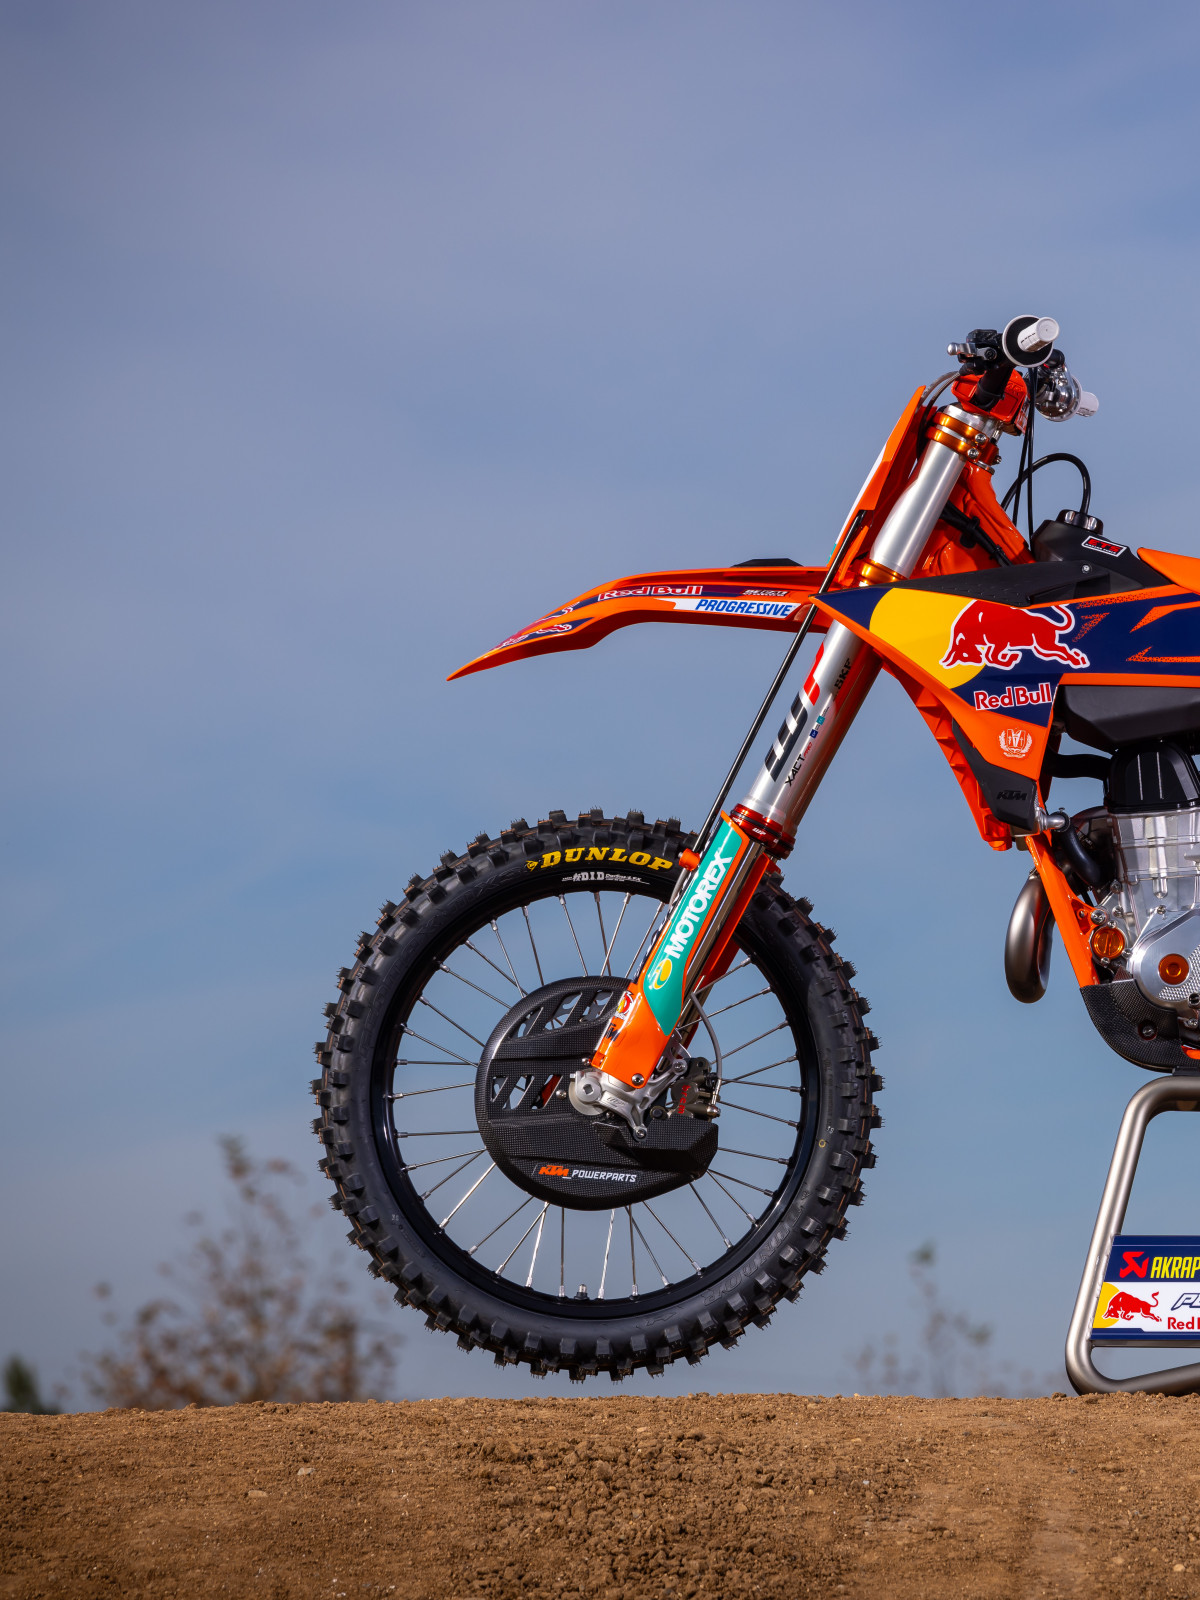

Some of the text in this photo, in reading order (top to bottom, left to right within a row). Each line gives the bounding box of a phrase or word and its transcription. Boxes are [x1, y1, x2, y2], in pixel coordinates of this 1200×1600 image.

[598, 585, 703, 601] Red Bull
[695, 598, 793, 617] PROGRESSIVE
[973, 682, 1053, 711] Red Bull
[785, 753, 806, 787] XACT
[996, 780, 1028, 801] KTM
[540, 847, 674, 871] DUNLOP
[664, 853, 733, 959] MOTOREX
[1167, 1317, 1196, 1330] Red
